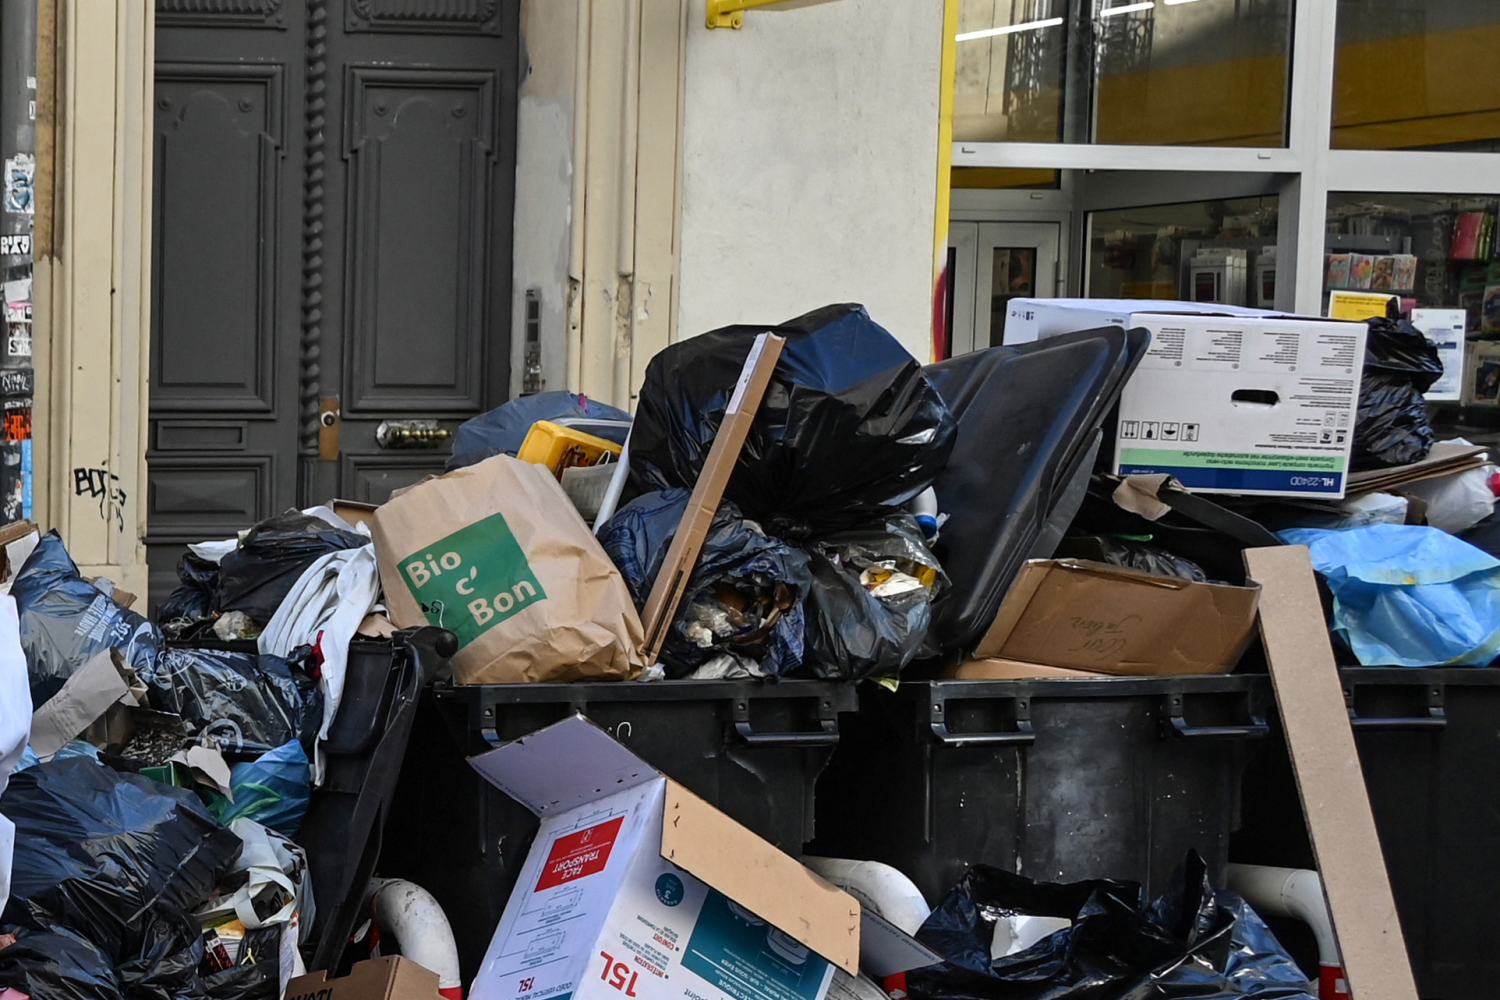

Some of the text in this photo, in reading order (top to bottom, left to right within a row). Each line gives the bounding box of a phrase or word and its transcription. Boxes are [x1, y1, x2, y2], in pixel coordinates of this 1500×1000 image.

[1289, 476, 1334, 487] HL-2240D
[406, 552, 461, 588] Bio
[467, 580, 537, 626] Bon
[549, 848, 601, 874] TRANSPORT
[559, 863, 585, 880] FACE
[663, 889, 672, 900] 3
[600, 951, 637, 998] 15L
[515, 976, 538, 993] 15L
[762, 984, 781, 999] MURAL
